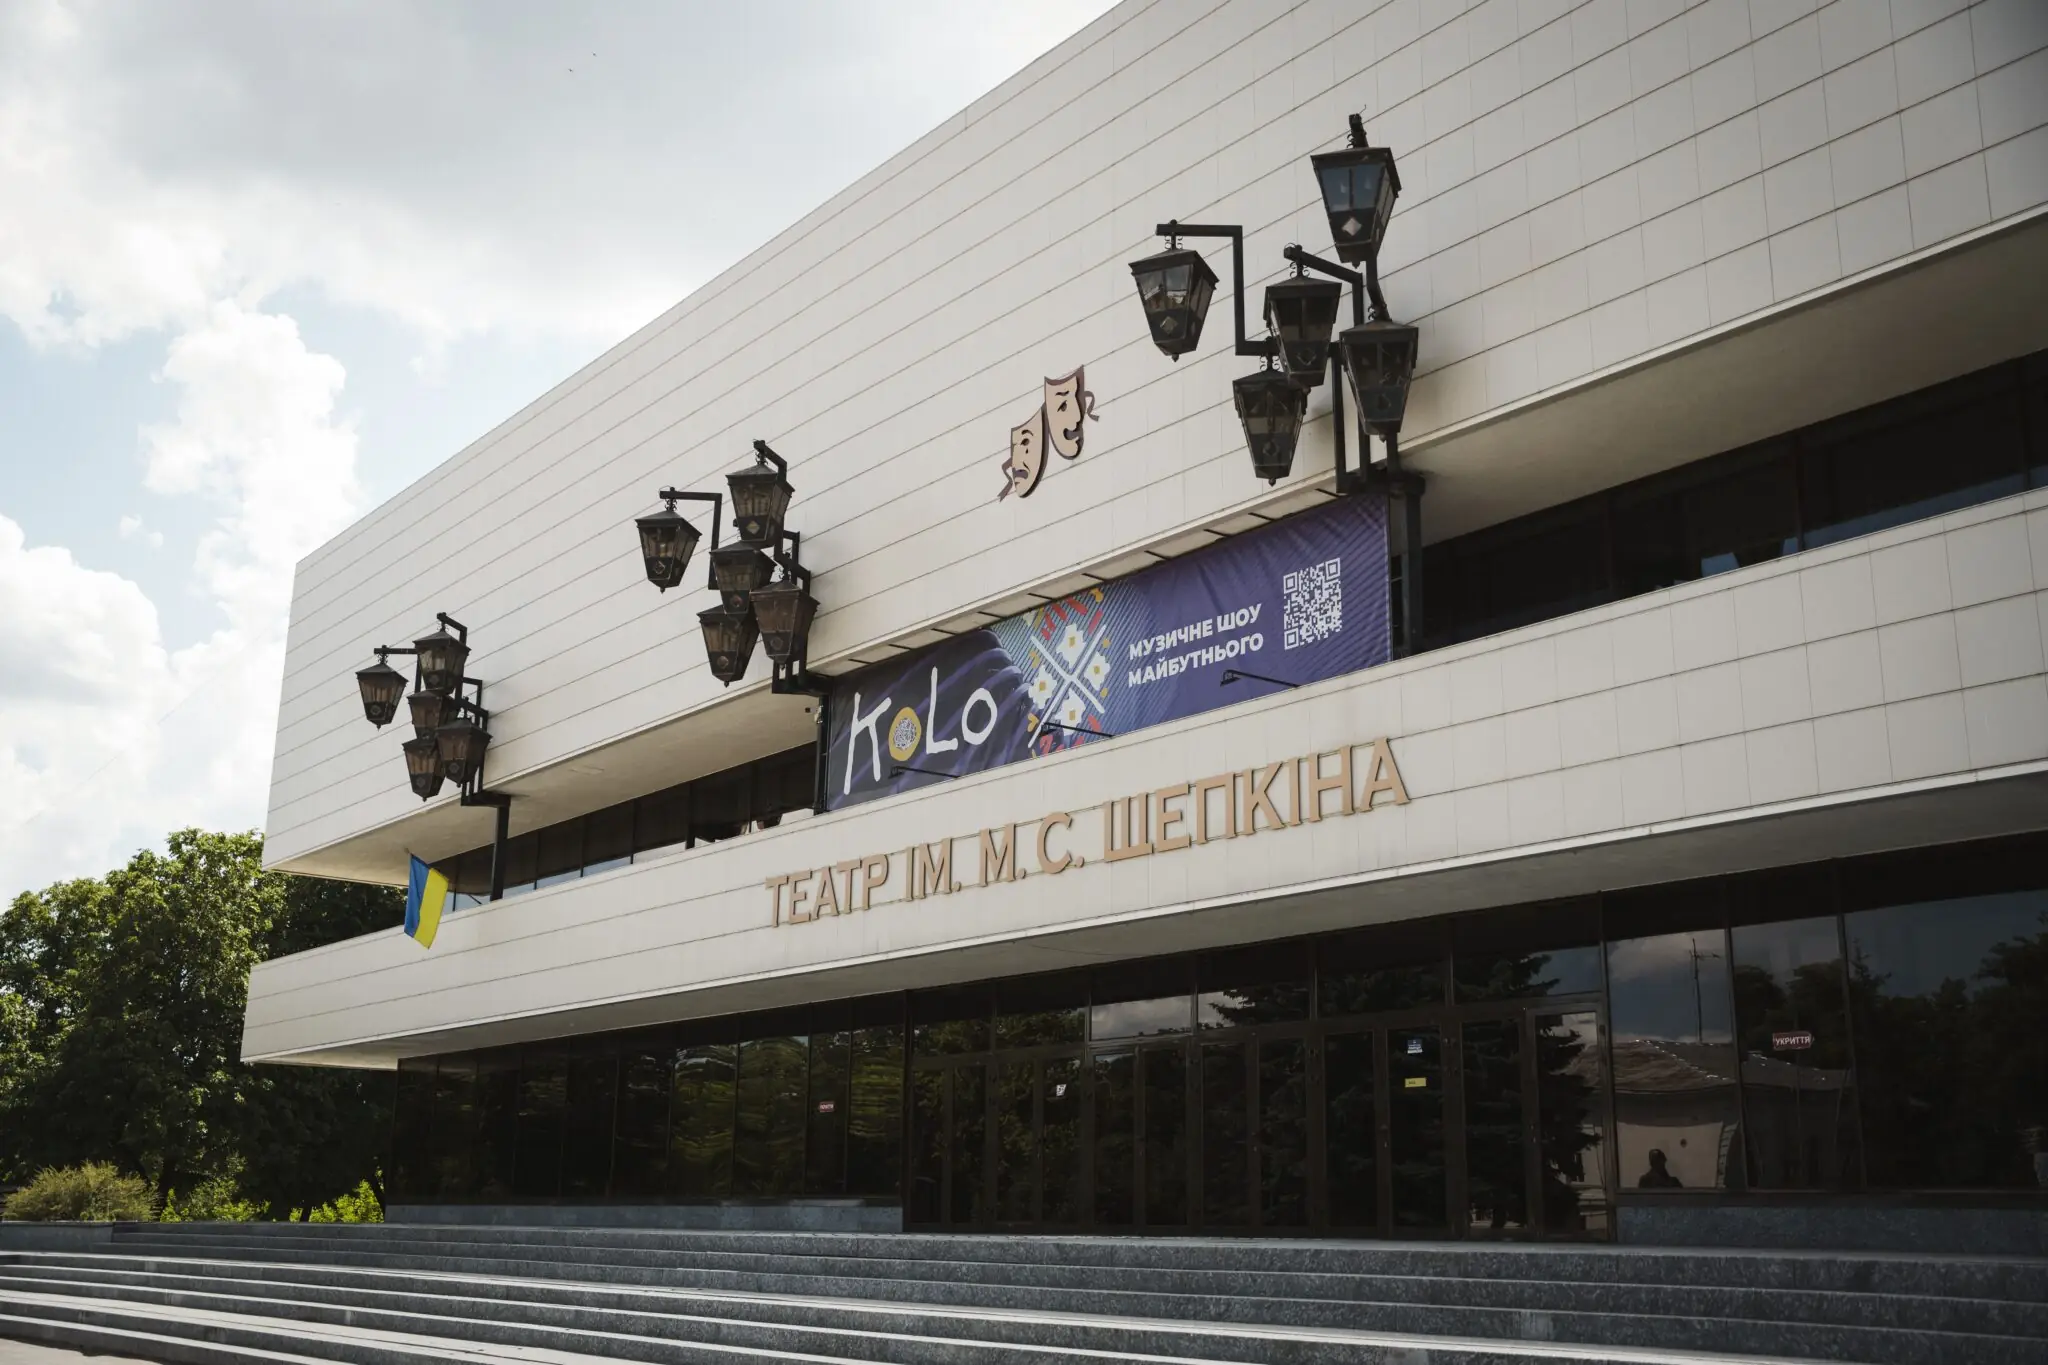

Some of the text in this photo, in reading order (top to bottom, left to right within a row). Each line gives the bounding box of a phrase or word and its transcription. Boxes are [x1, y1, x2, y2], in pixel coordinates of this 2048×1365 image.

[1128, 603, 1262, 661] МУЗИЧНЕ ШОУ
[1128, 632, 1264, 687] МАЙБУТНЬОГО
[765, 853, 889, 927] ТЕАТР
[905, 837, 961, 902] ІМ.
[979, 823, 1027, 887] М.
[1036, 811, 1085, 874] С.
[1775, 1036, 1811, 1045] УКРИТТЯ
